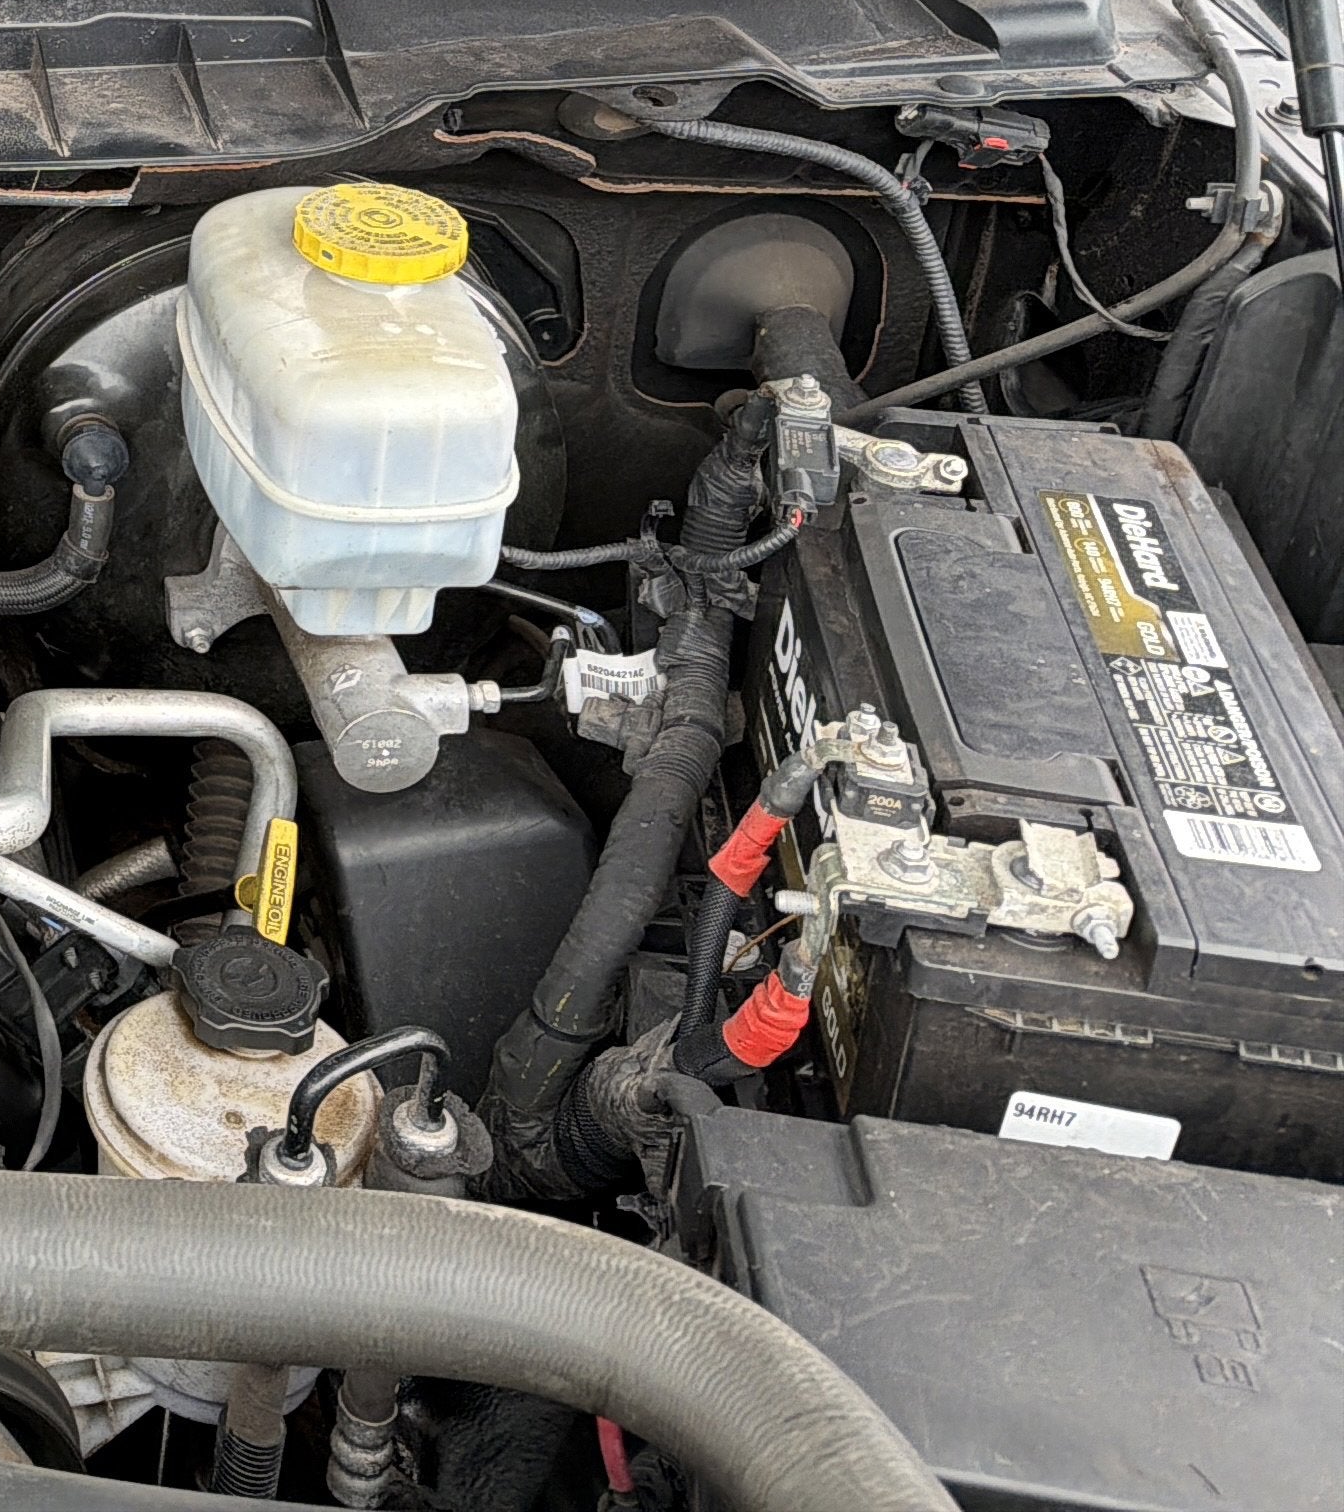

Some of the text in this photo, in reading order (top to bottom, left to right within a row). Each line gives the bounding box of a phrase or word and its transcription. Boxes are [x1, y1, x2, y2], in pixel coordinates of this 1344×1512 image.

[1112, 502, 1181, 591] DieHard
[1136, 621, 1166, 656] GOLD
[867, 794, 902, 810] 200A
[265, 844, 290, 935] ENGINE OIL
[820, 984, 848, 1079] GOLD
[1012, 1102, 1077, 1127] 94RH7
